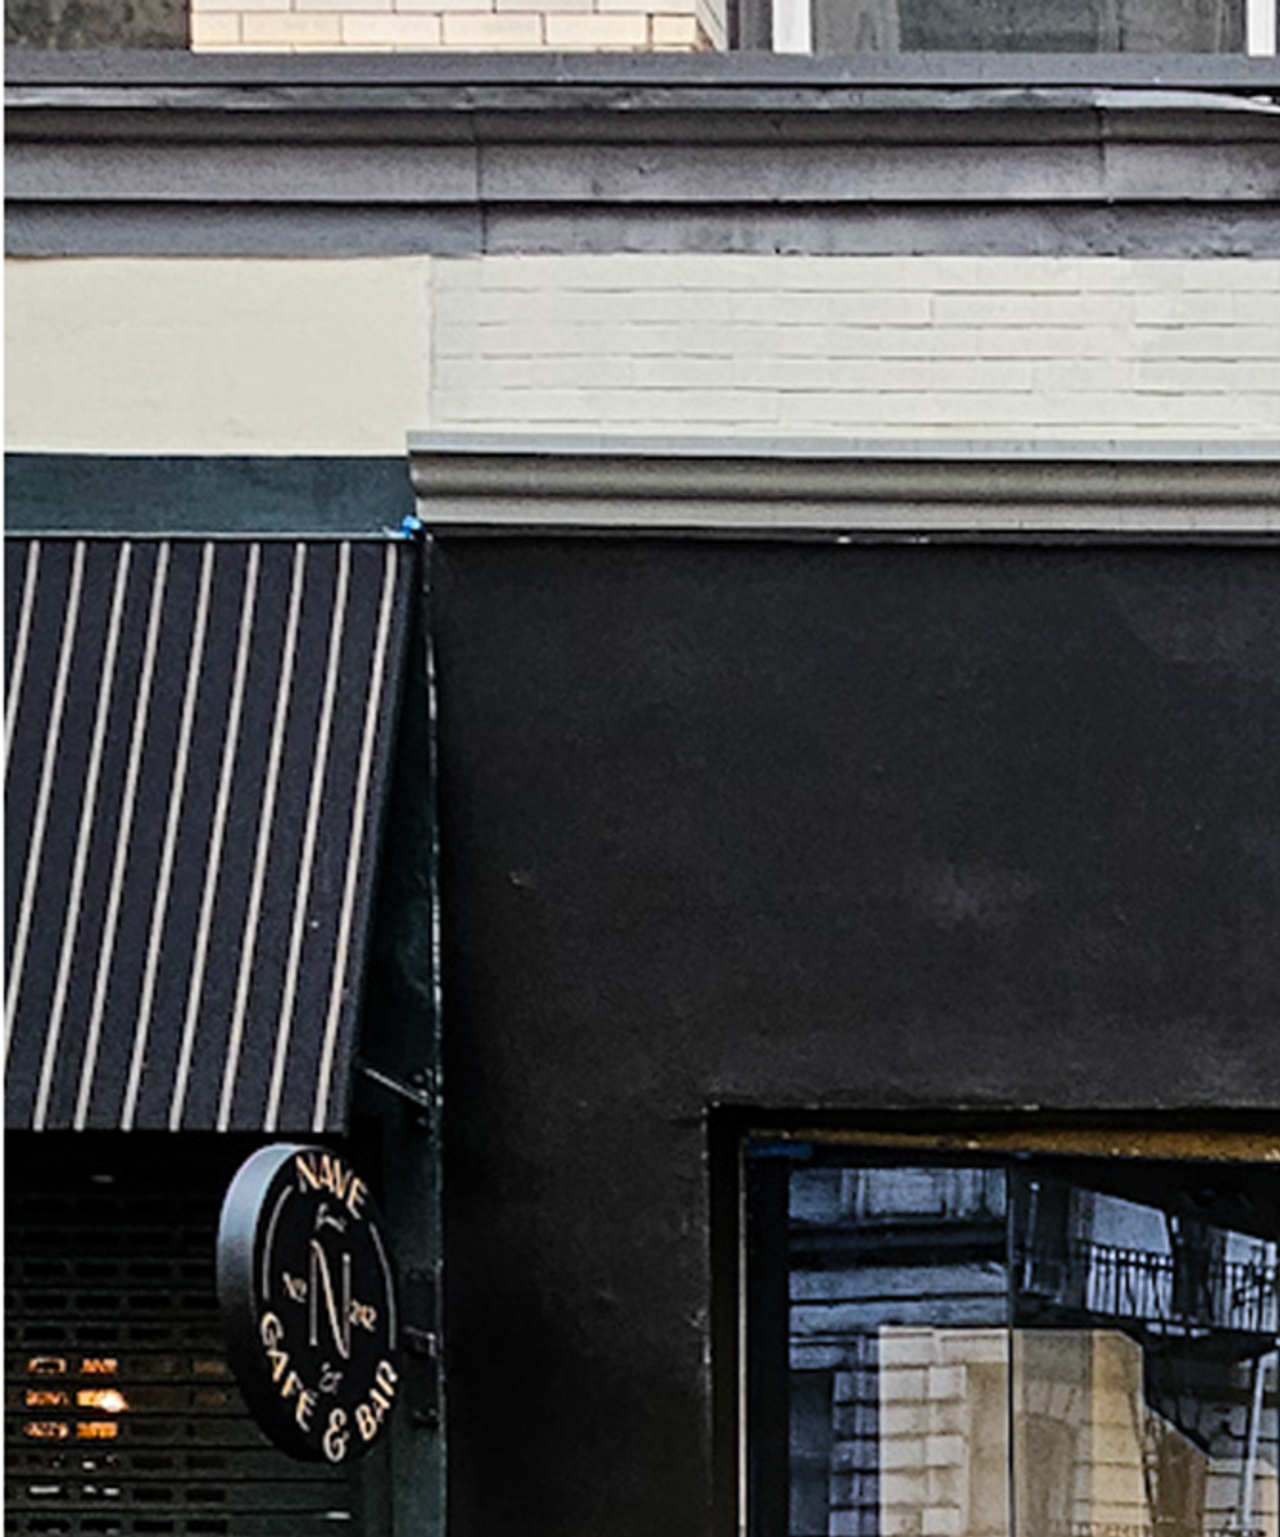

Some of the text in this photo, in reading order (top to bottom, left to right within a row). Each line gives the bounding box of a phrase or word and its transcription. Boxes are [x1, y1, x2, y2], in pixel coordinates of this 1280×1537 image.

[296, 1154, 367, 1220] NAVE
[323, 1409, 348, 1463] &
[355, 1360, 397, 1441] BAR
